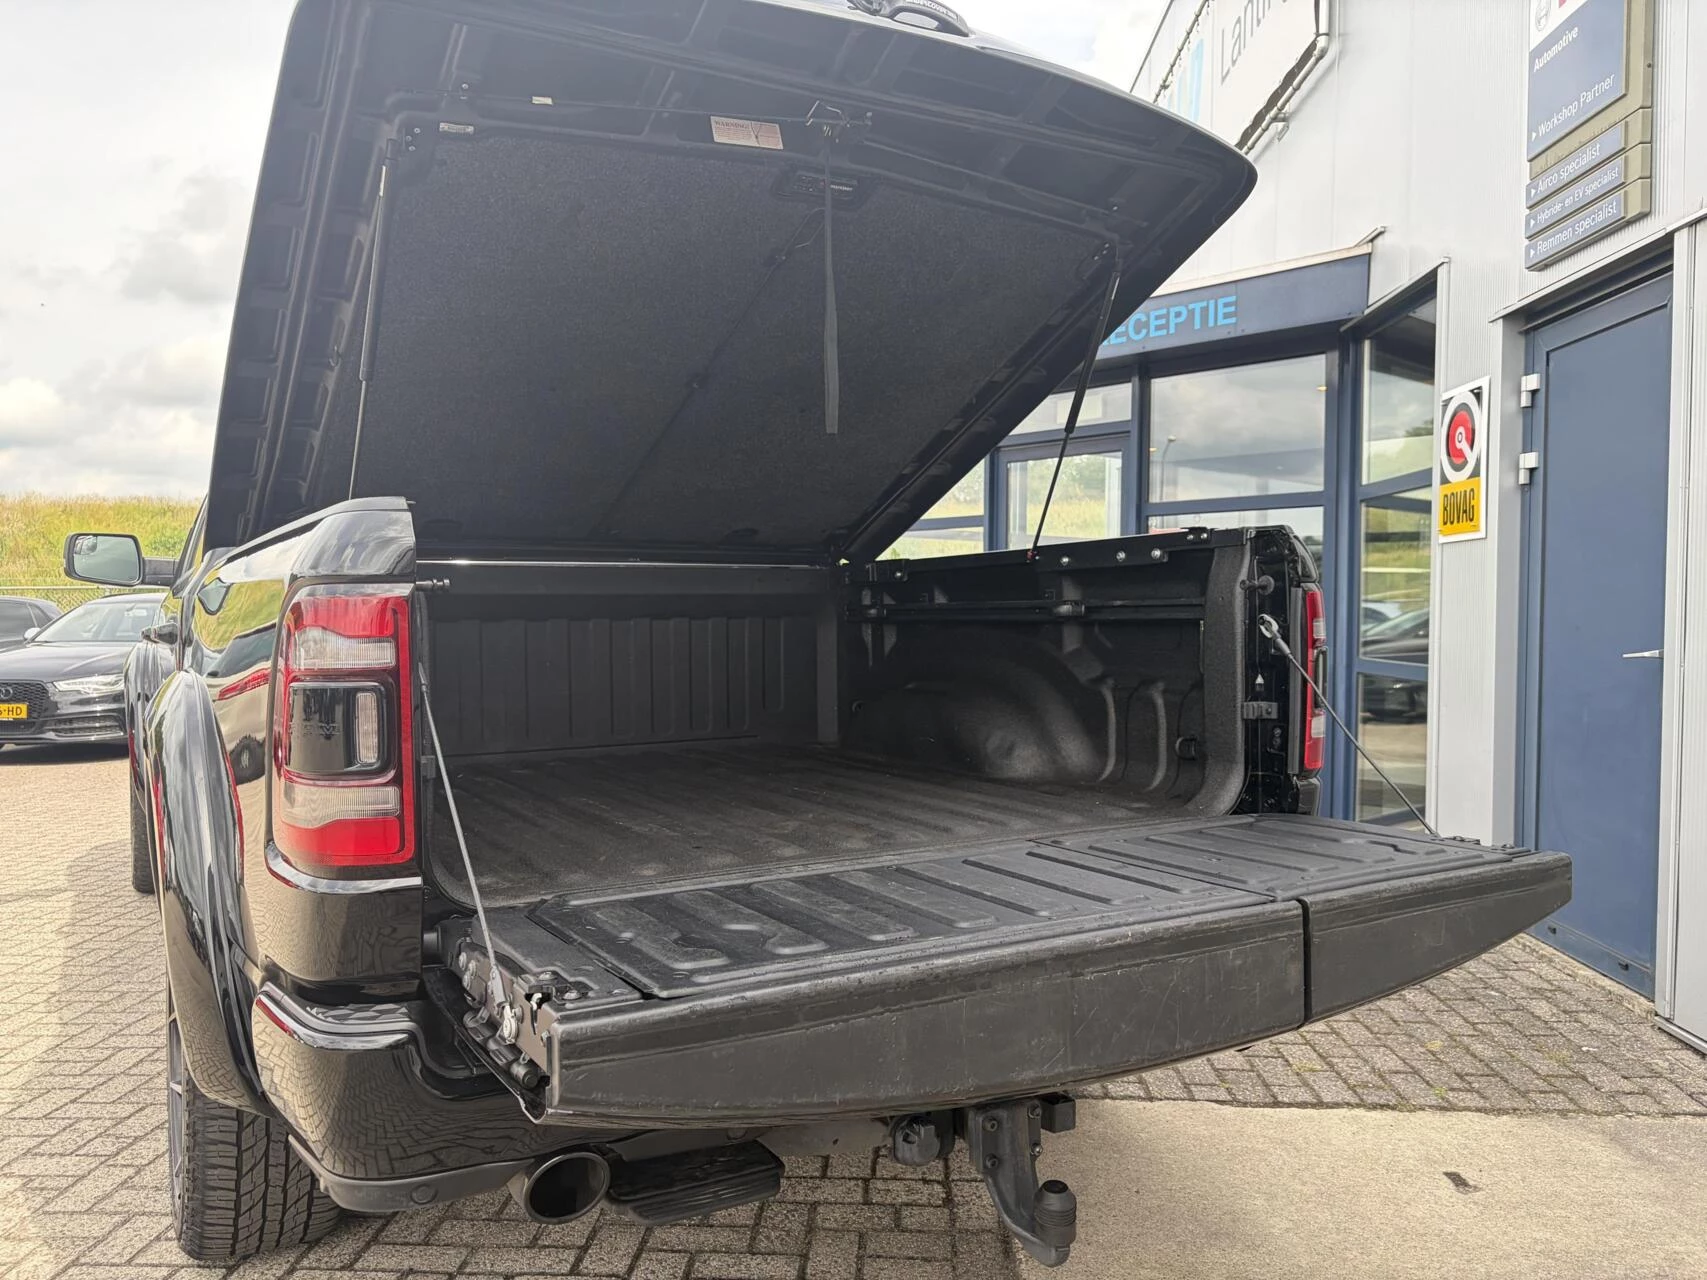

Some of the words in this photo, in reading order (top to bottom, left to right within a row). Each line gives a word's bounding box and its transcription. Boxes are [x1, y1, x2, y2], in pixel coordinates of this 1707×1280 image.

[1533, 26, 1579, 72] Automotive
[1538, 101, 1578, 137] Workshop
[1580, 74, 1615, 107] Partner
[1537, 172, 1558, 194] Airco
[1560, 142, 1600, 183] specialist
[1536, 202, 1564, 224] Hybride-
[1564, 195, 1574, 207] en
[1574, 188, 1584, 201] EV
[1584, 166, 1618, 196] specialist
[1537, 228, 1573, 255] Remmen
[1575, 199, 1617, 235] specialist
[1103, 295, 1237, 346] ECEPTIE
[1443, 488, 1475, 525] BOVAG
